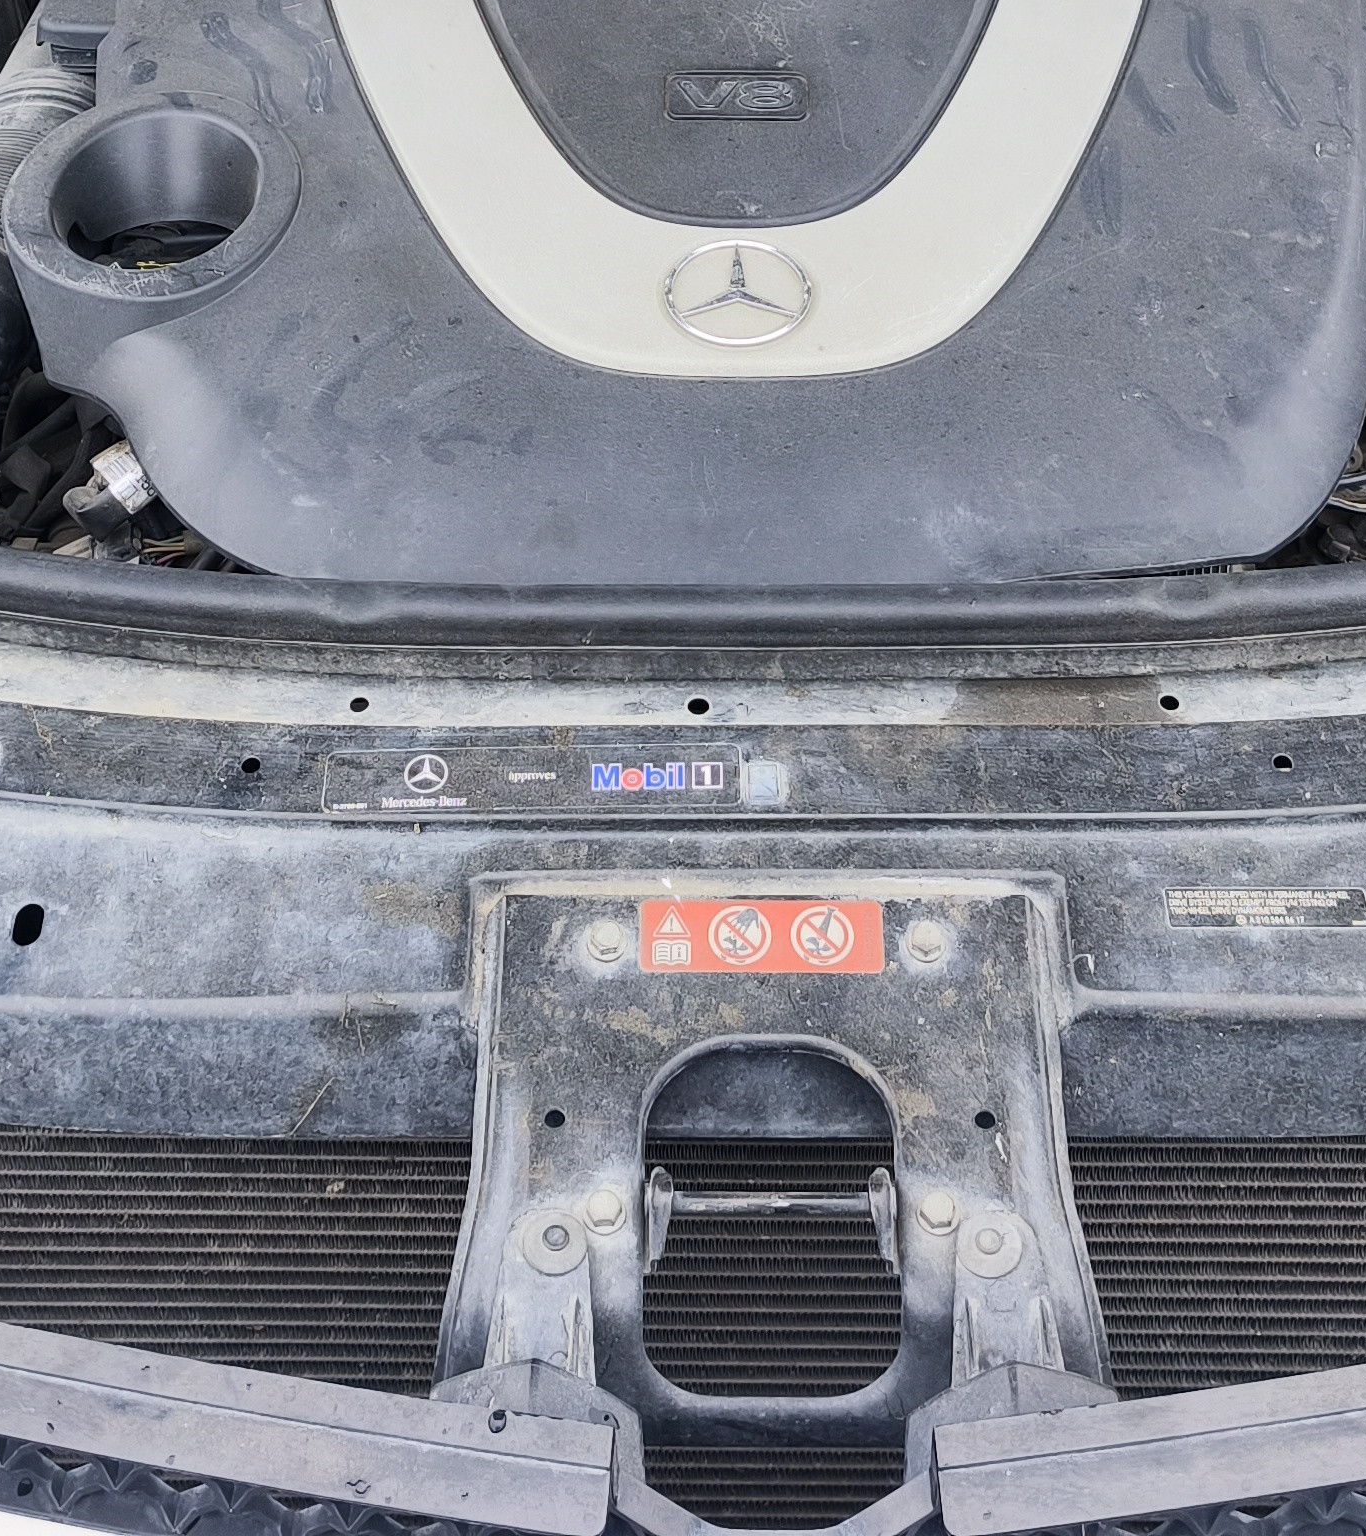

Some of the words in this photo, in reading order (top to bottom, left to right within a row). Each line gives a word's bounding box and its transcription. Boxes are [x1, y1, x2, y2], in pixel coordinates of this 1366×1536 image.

[676, 80, 794, 111] V8
[508, 770, 557, 783] approves
[591, 763, 685, 791] Mobil
[381, 795, 467, 808] Mercedes-Benz
